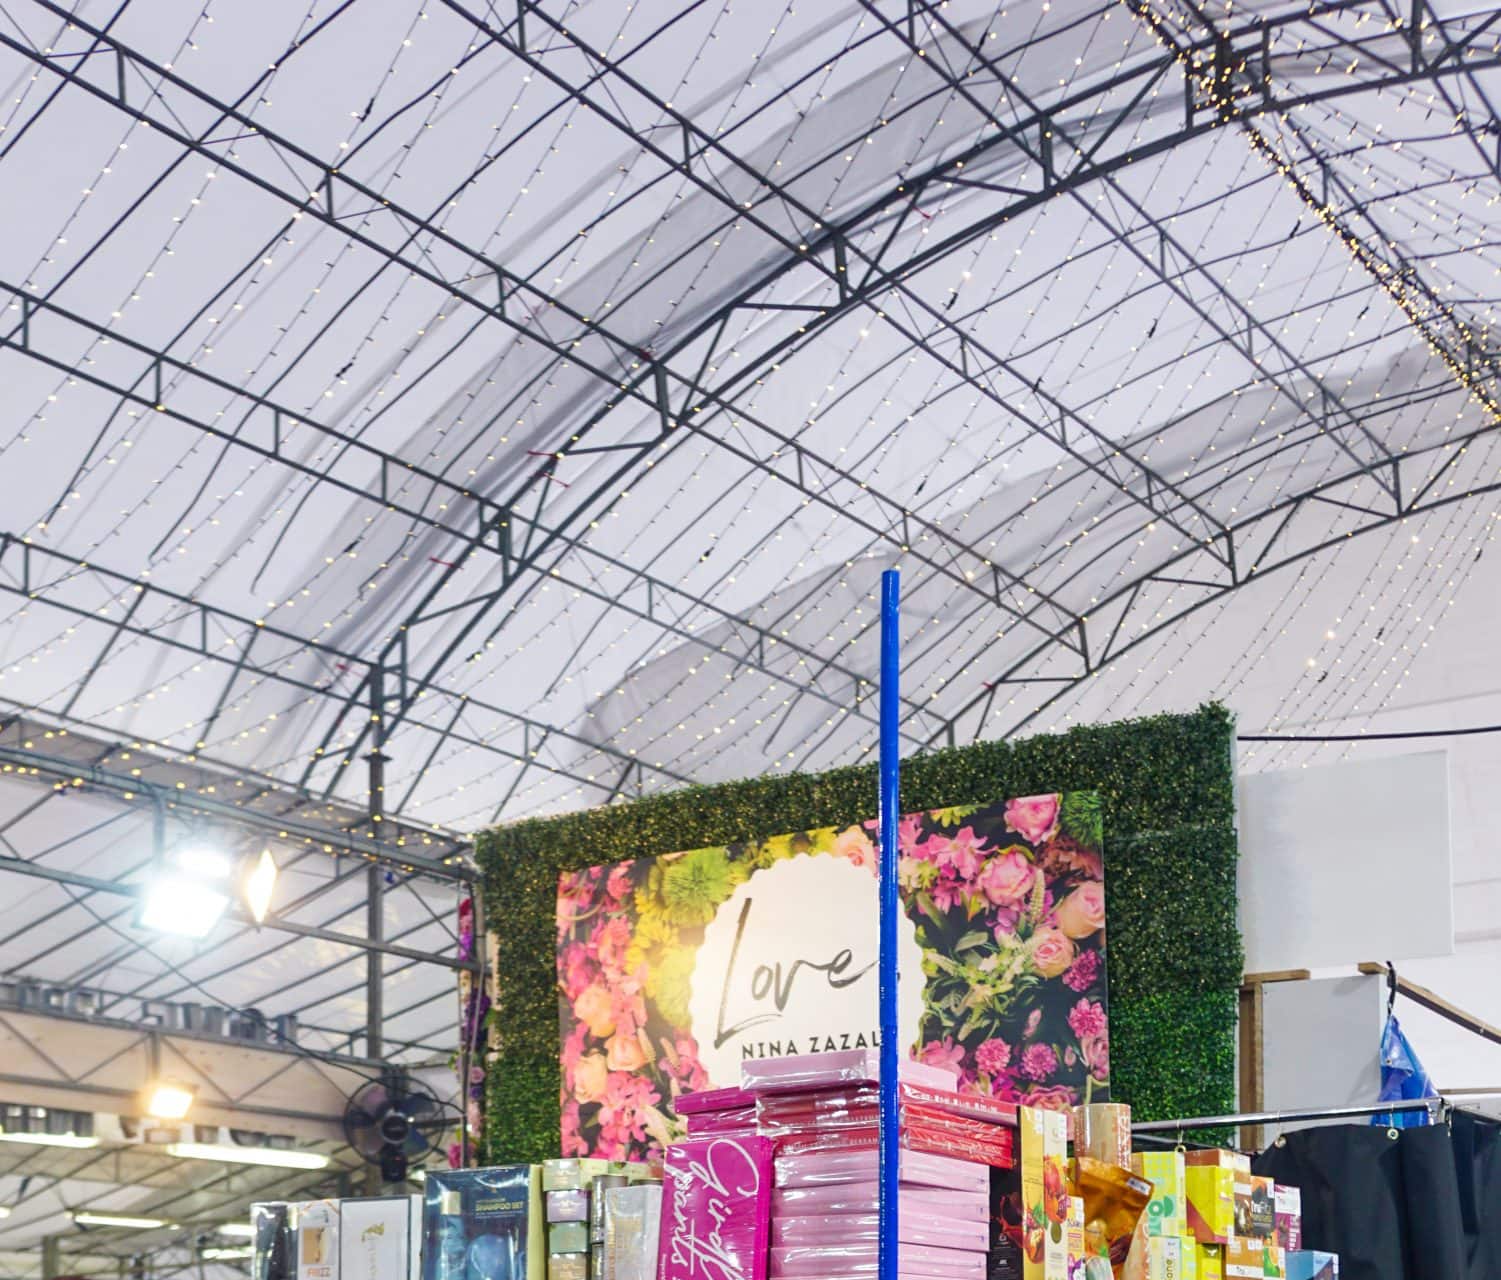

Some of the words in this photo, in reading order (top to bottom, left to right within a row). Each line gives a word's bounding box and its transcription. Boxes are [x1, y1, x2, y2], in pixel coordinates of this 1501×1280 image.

[714, 898, 879, 1049] Love
[742, 1040, 798, 1059] NINA
[809, 1031, 882, 1053] ZAZAL
